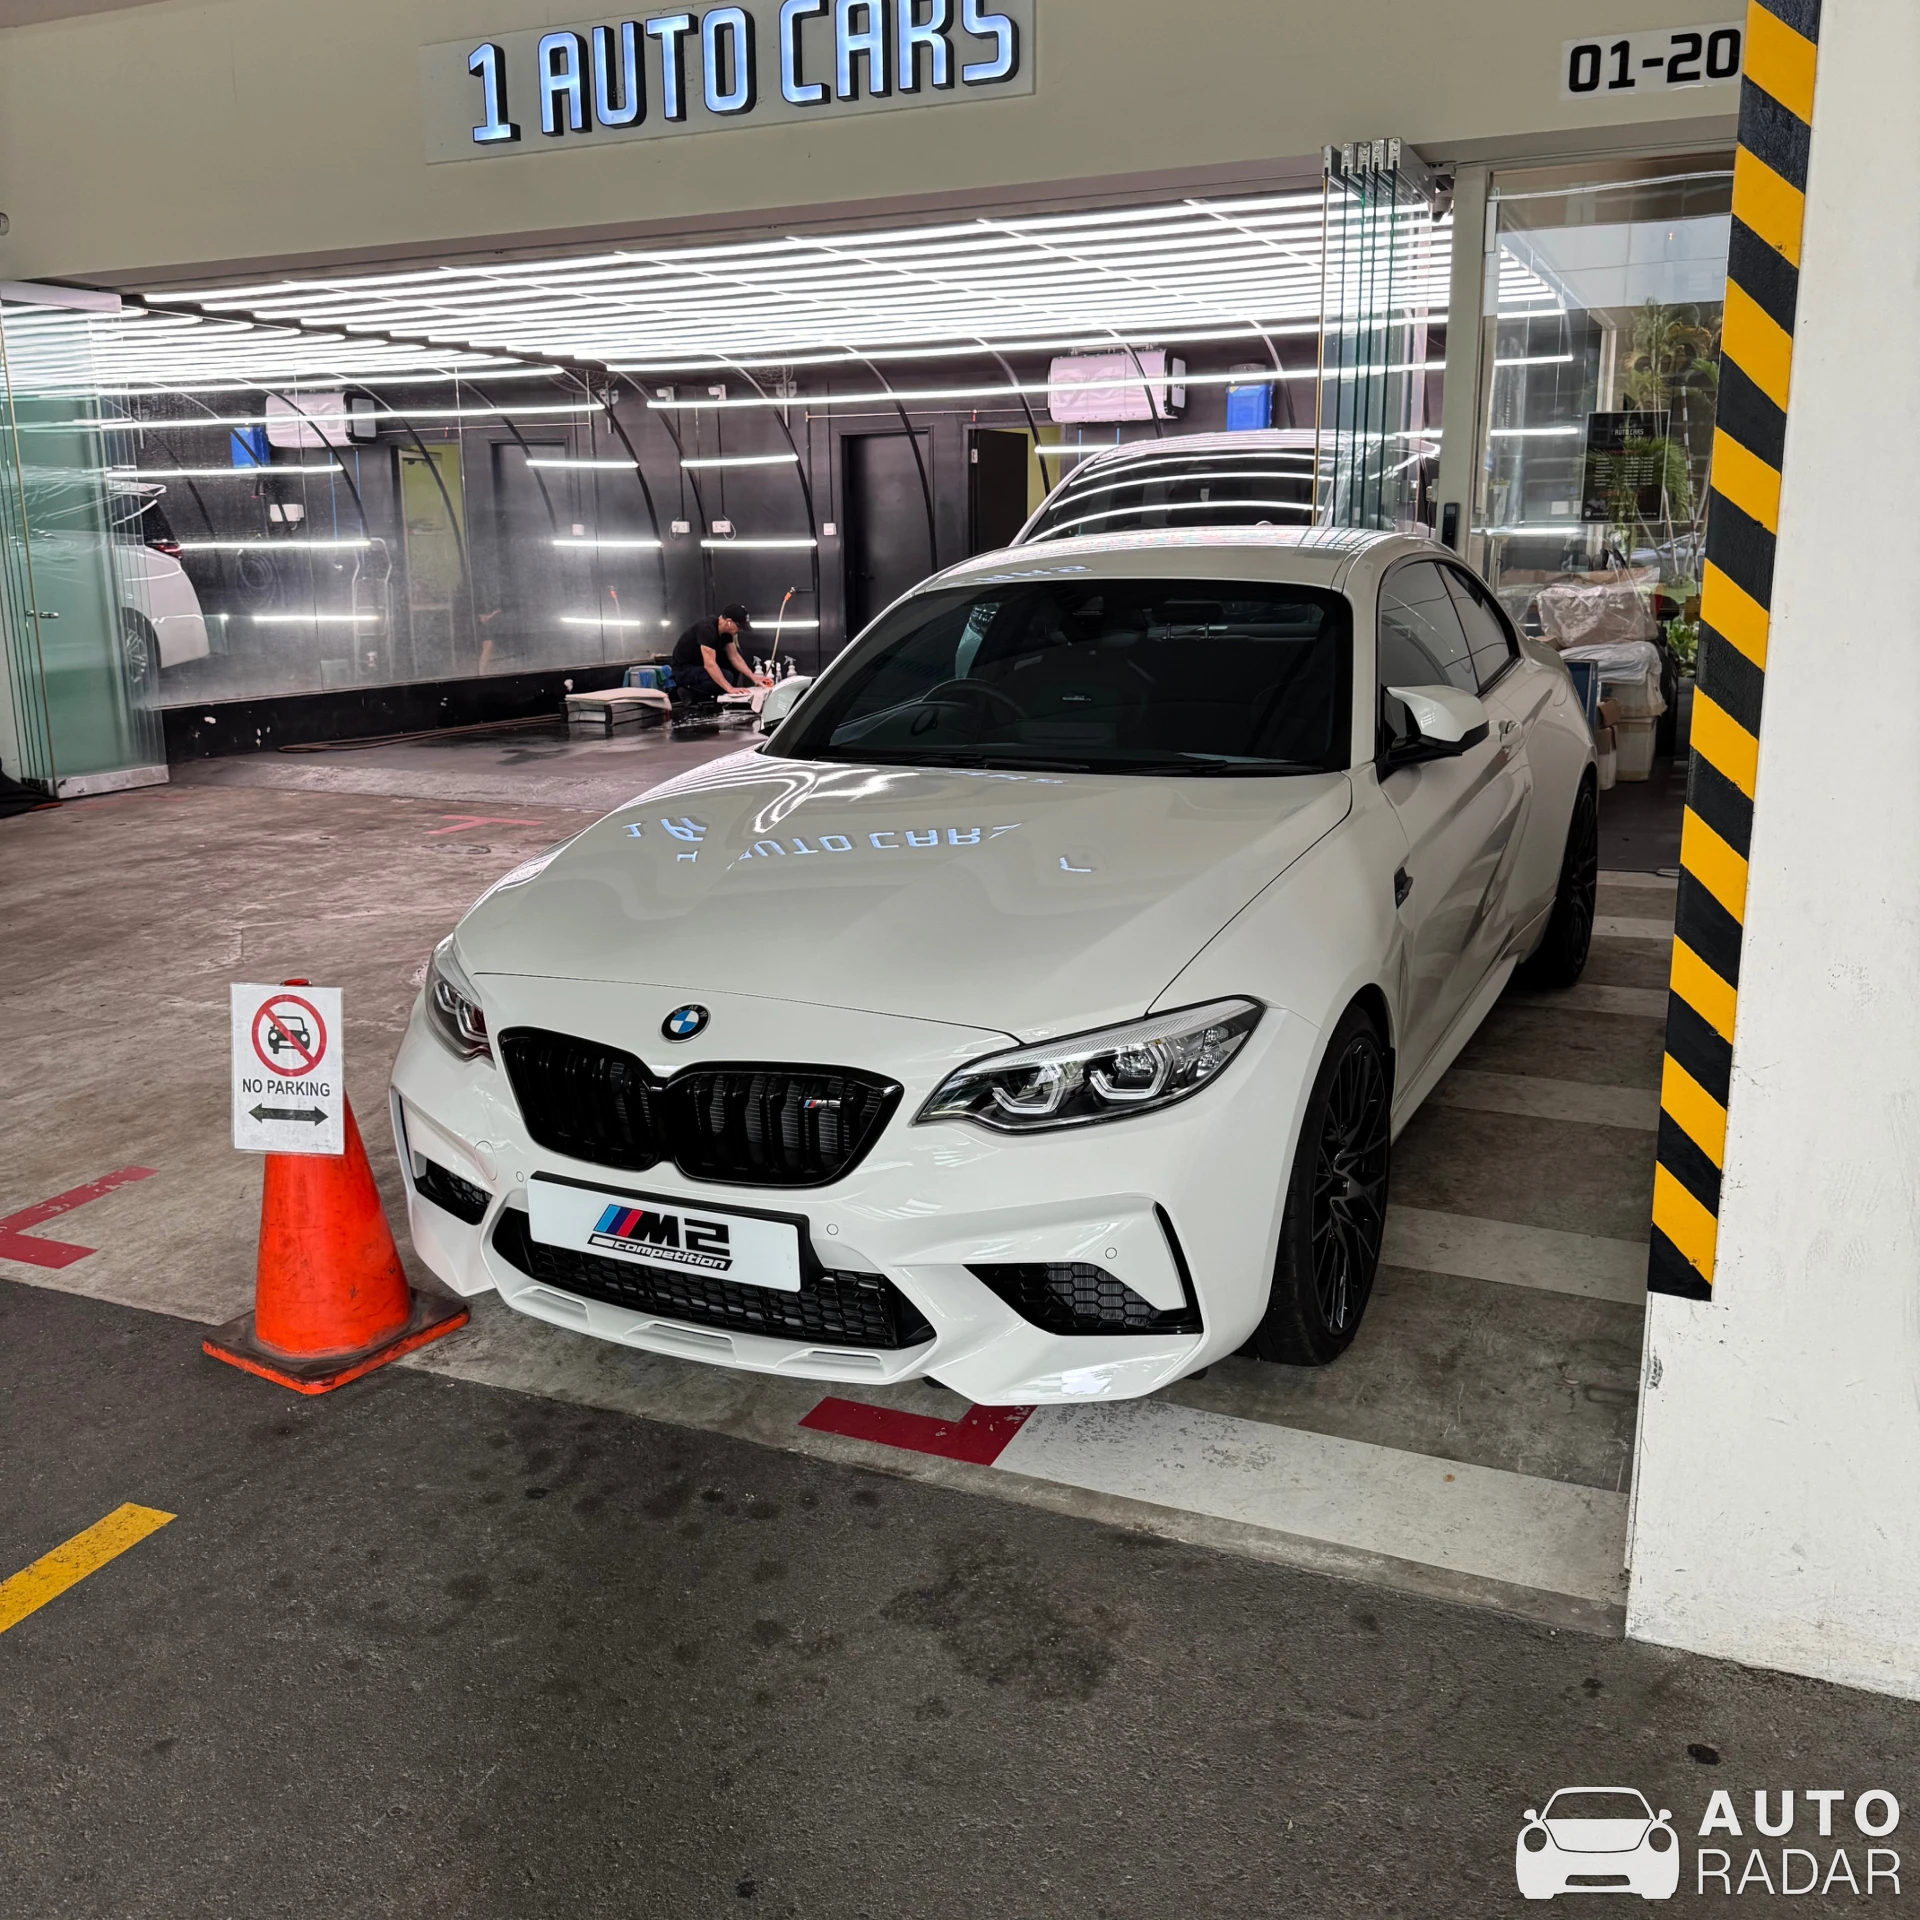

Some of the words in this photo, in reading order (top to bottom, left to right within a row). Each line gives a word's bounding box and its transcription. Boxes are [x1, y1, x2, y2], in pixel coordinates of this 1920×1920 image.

[467, 42, 521, 144] 1
[538, 6, 758, 136] AUTO
[780, 0, 1020, 107] CARS
[1568, 28, 1742, 93] 01-20
[242, 1078, 263, 1093] NO
[267, 1079, 331, 1097] PARKING
[612, 1240, 728, 1270] competition
[624, 1208, 731, 1258] M2
